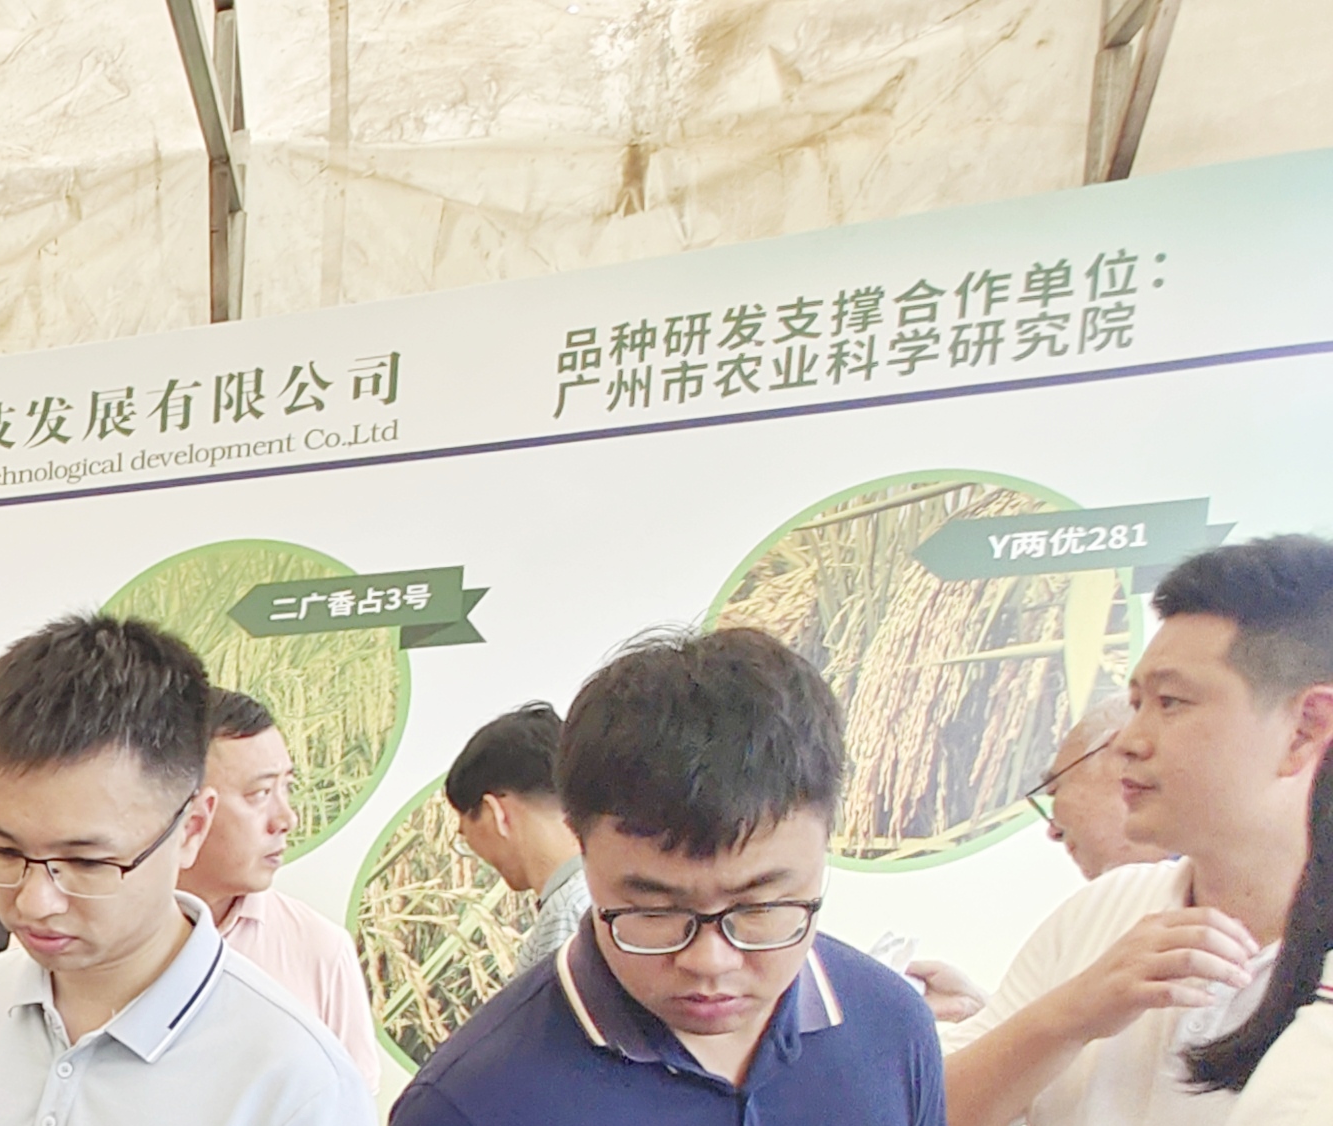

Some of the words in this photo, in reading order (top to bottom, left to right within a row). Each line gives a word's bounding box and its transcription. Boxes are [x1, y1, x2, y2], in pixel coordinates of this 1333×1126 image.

[555, 248, 1168, 374] 品种研发支撑合作单位：
[552, 301, 1136, 420] 广州市农业科学研究院
[130, 433, 296, 472] development
[988, 522, 1149, 561] Y两优281
[269, 583, 432, 621] 二广香占3号
